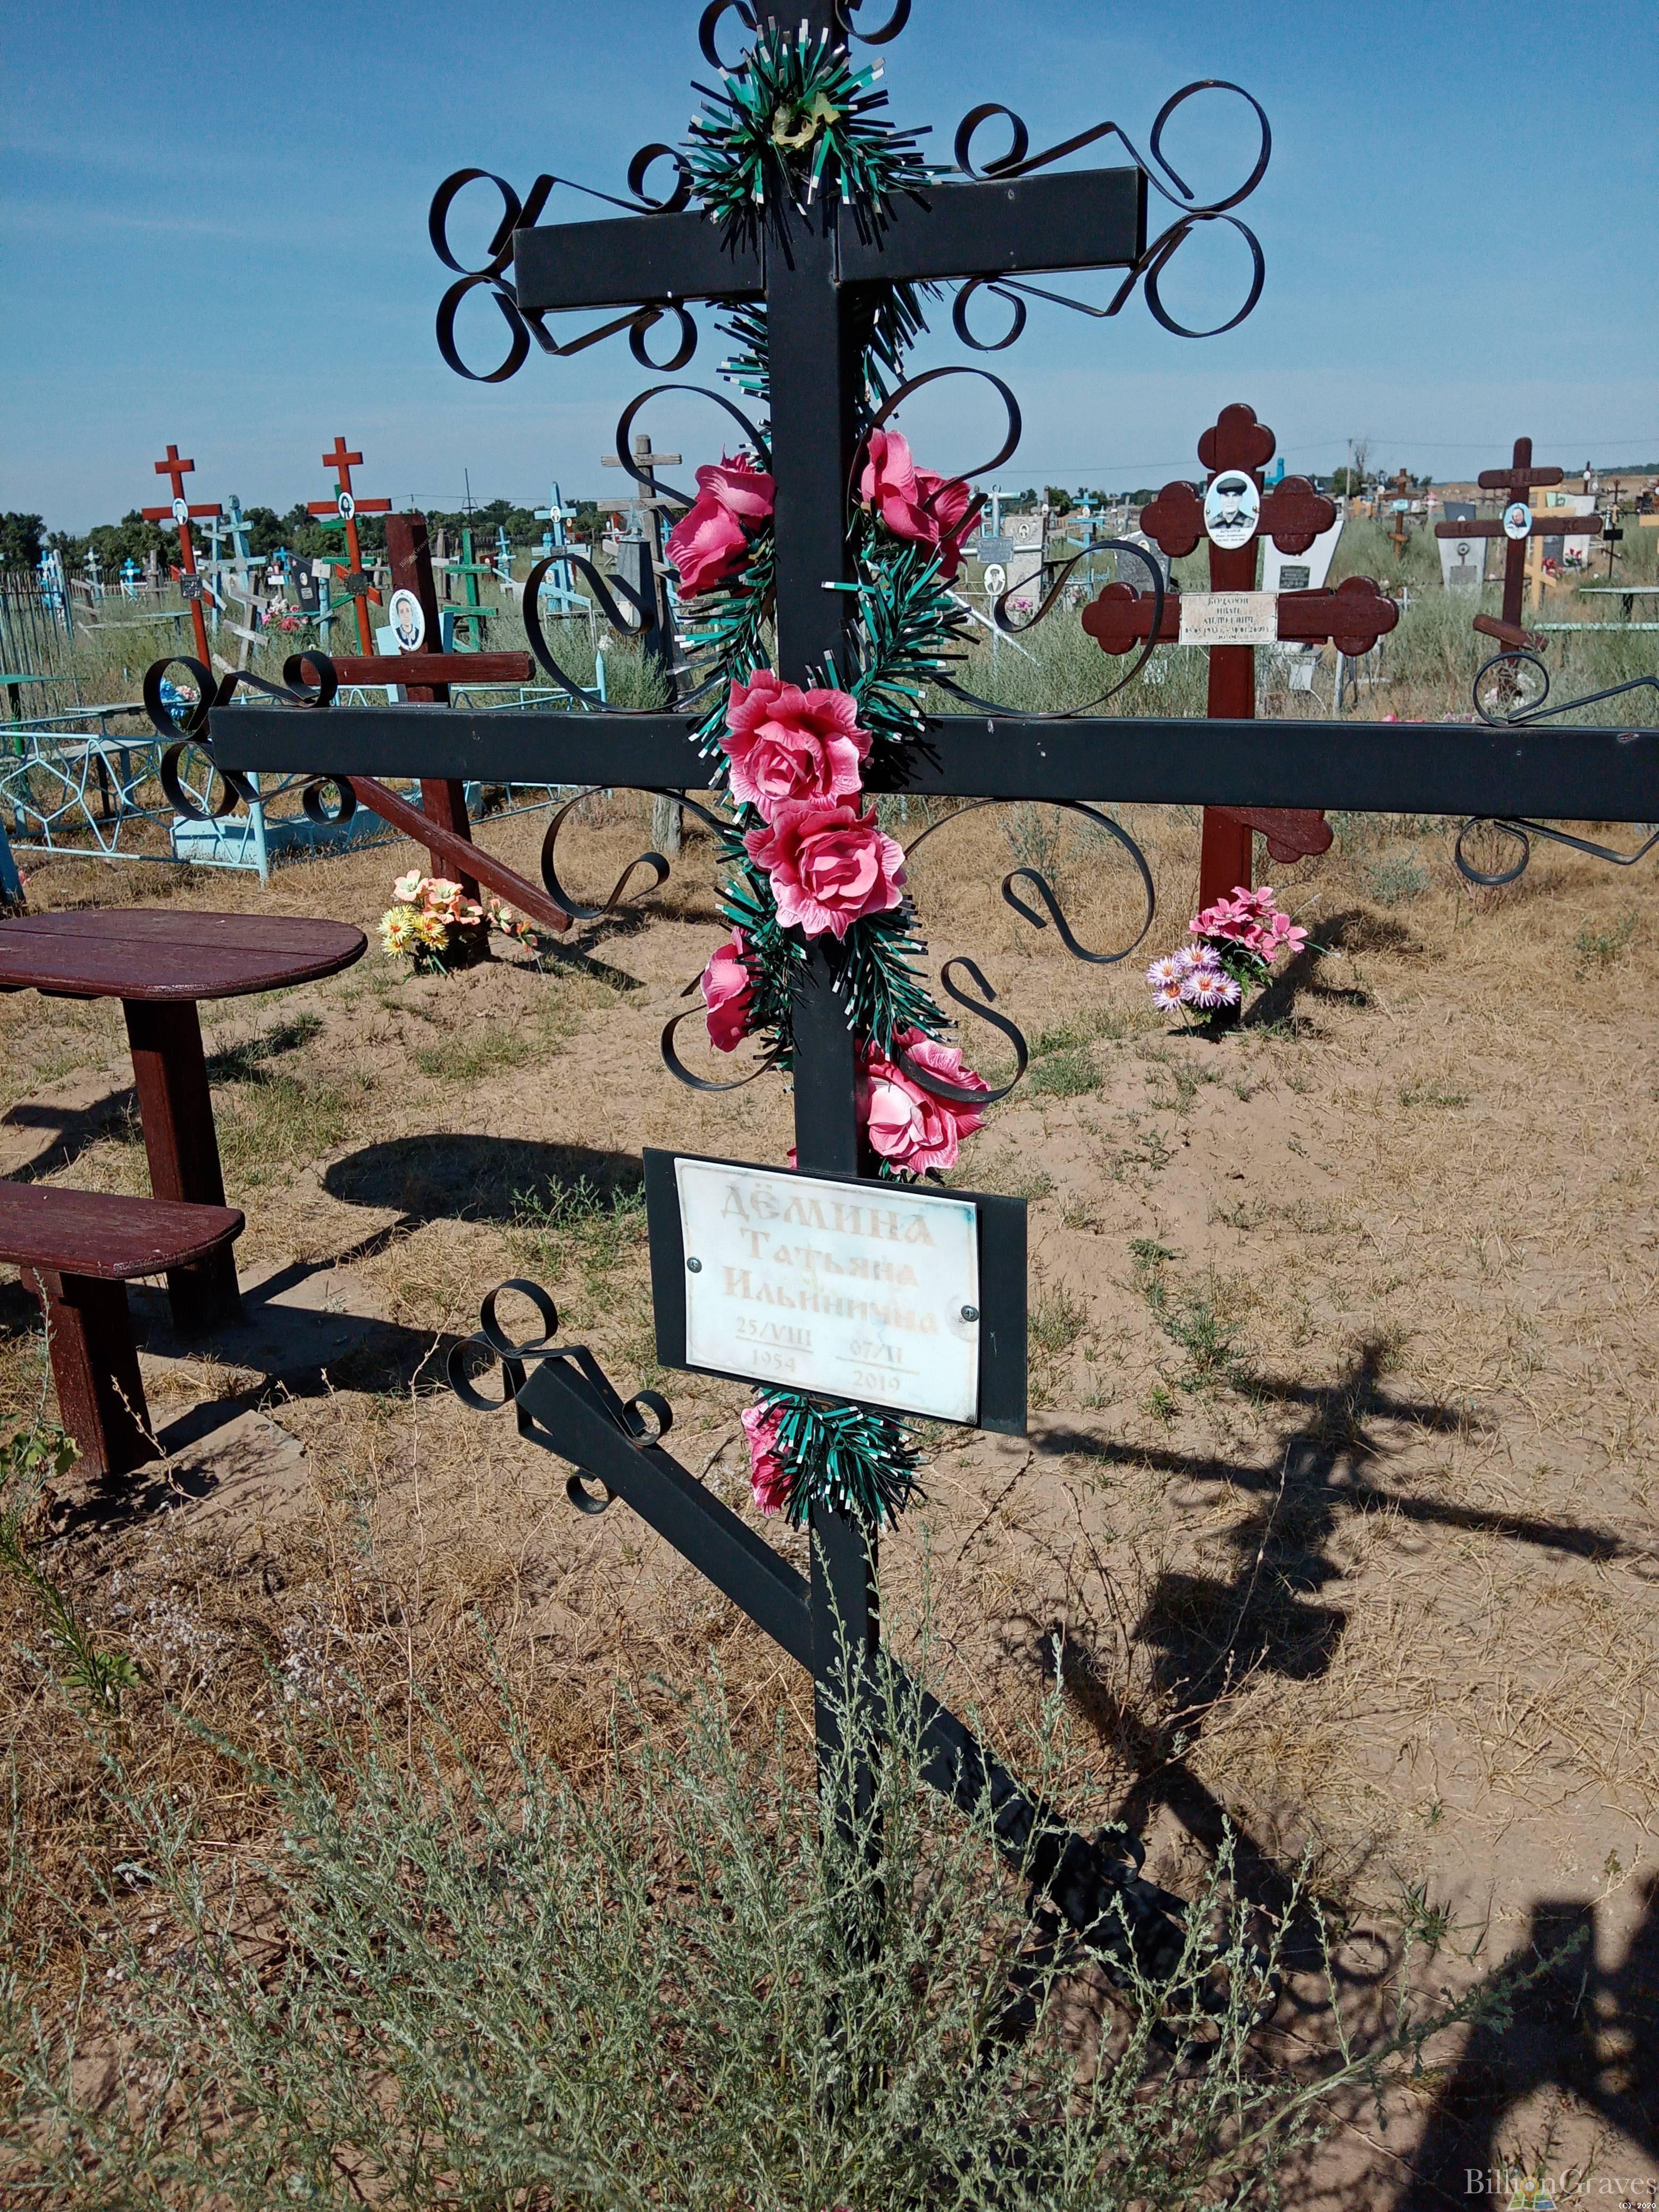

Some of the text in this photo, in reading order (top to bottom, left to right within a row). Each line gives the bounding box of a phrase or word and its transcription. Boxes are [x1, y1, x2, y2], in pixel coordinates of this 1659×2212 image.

[720, 1182, 937, 1247] ДЁМИНА
[739, 1226, 919, 1288] Татьяна
[722, 1264, 941, 1336] Ильинична
[736, 1316, 812, 1346] 25/VIII
[752, 1349, 798, 1373] 1954
[852, 1369, 901, 1394] 2019
